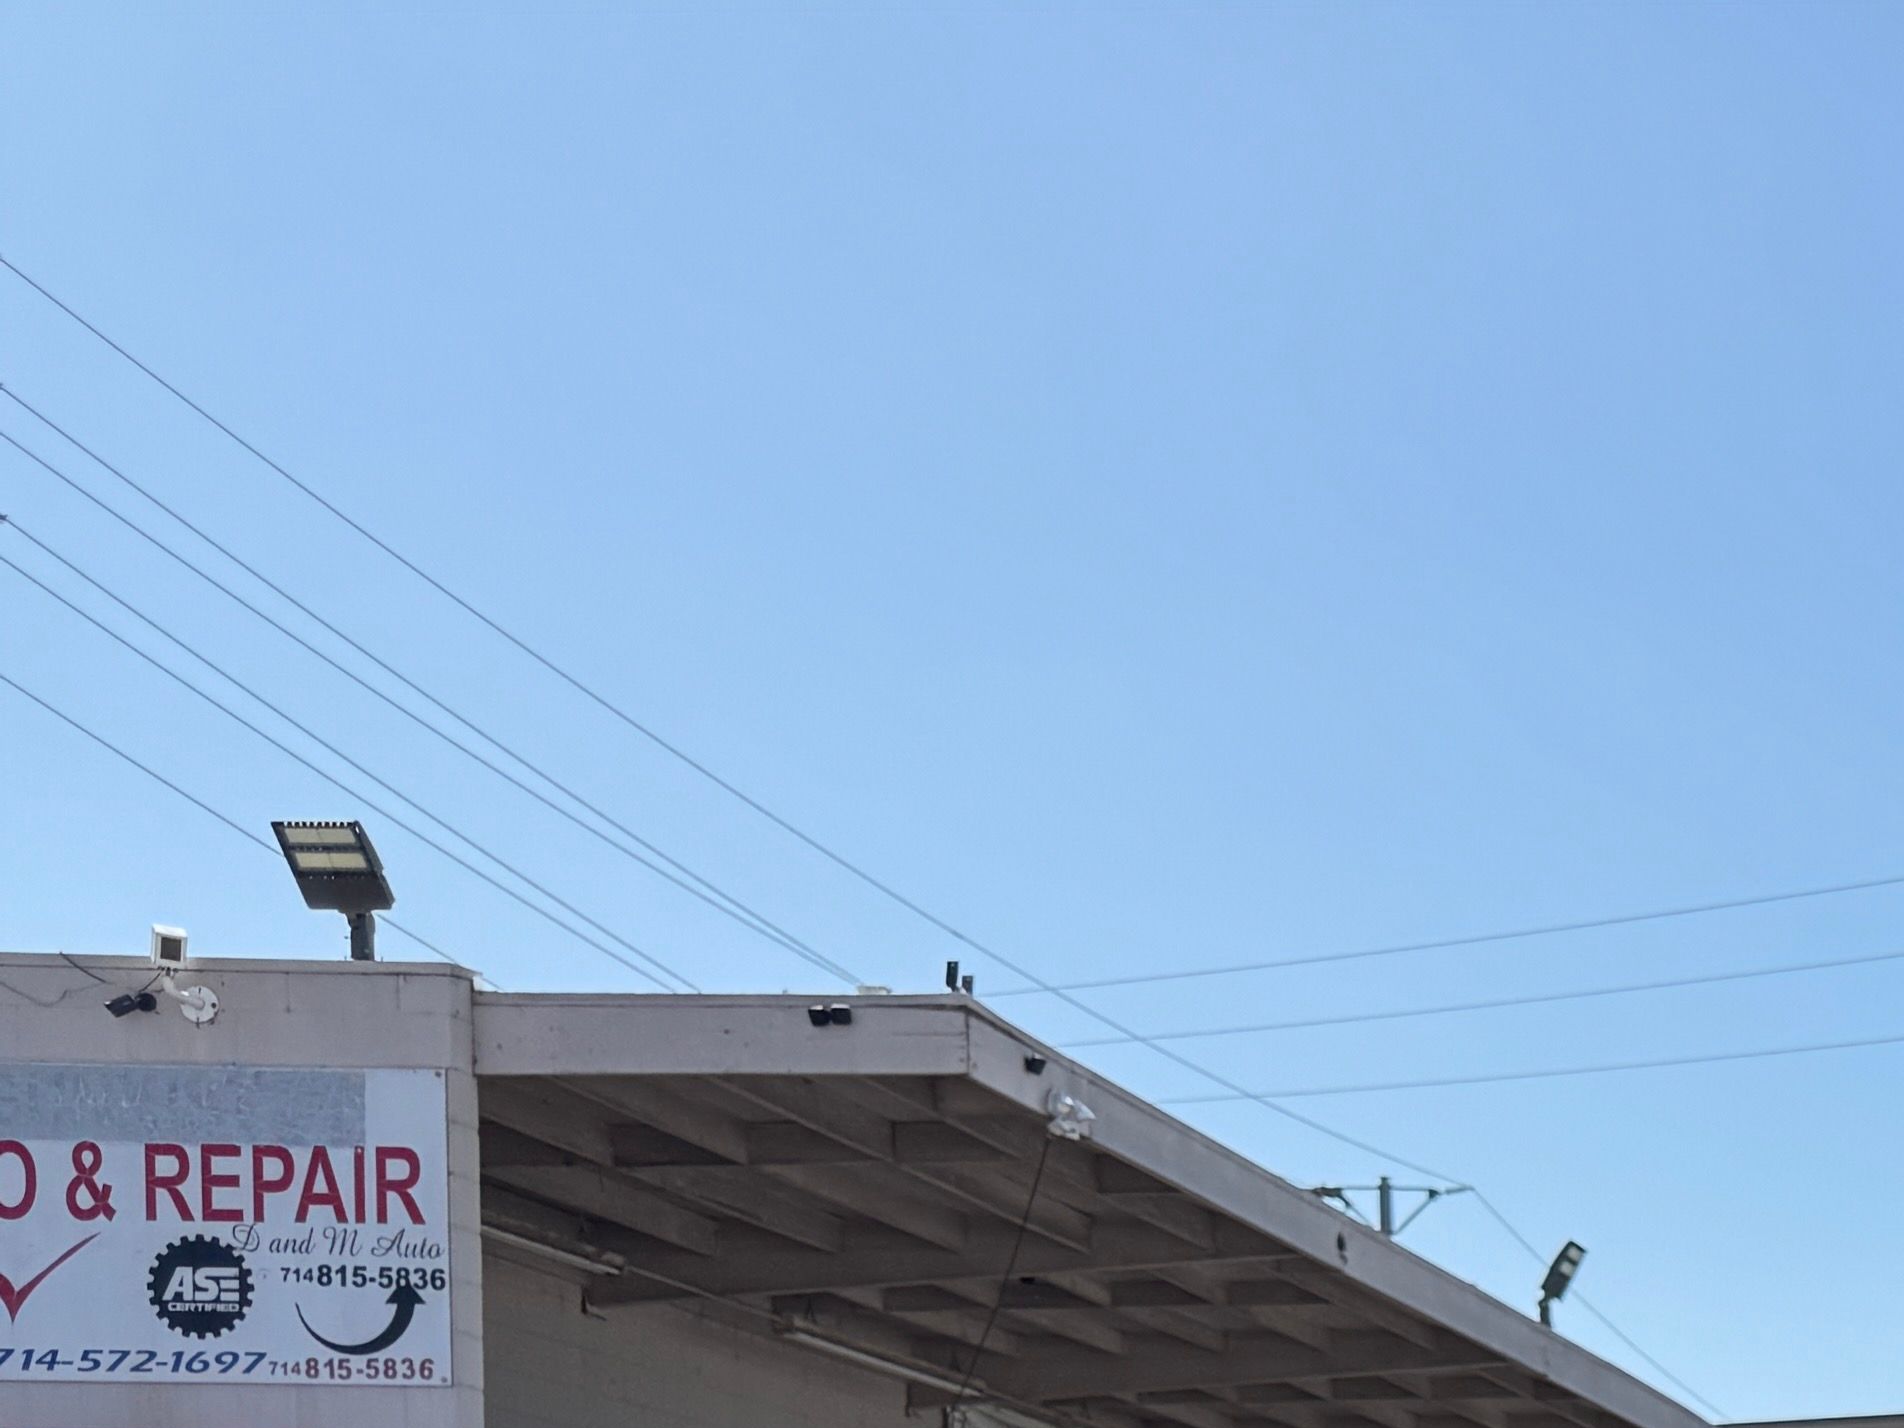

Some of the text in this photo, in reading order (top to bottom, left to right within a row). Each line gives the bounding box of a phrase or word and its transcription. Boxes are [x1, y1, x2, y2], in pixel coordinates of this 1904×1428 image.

[66, 1140, 117, 1222] &
[144, 1142, 427, 1226] REPAIR
[232, 1223, 446, 1260] D and M Auto
[162, 1266, 240, 1301] ASE
[167, 1301, 240, 1312] CERTIFIED
